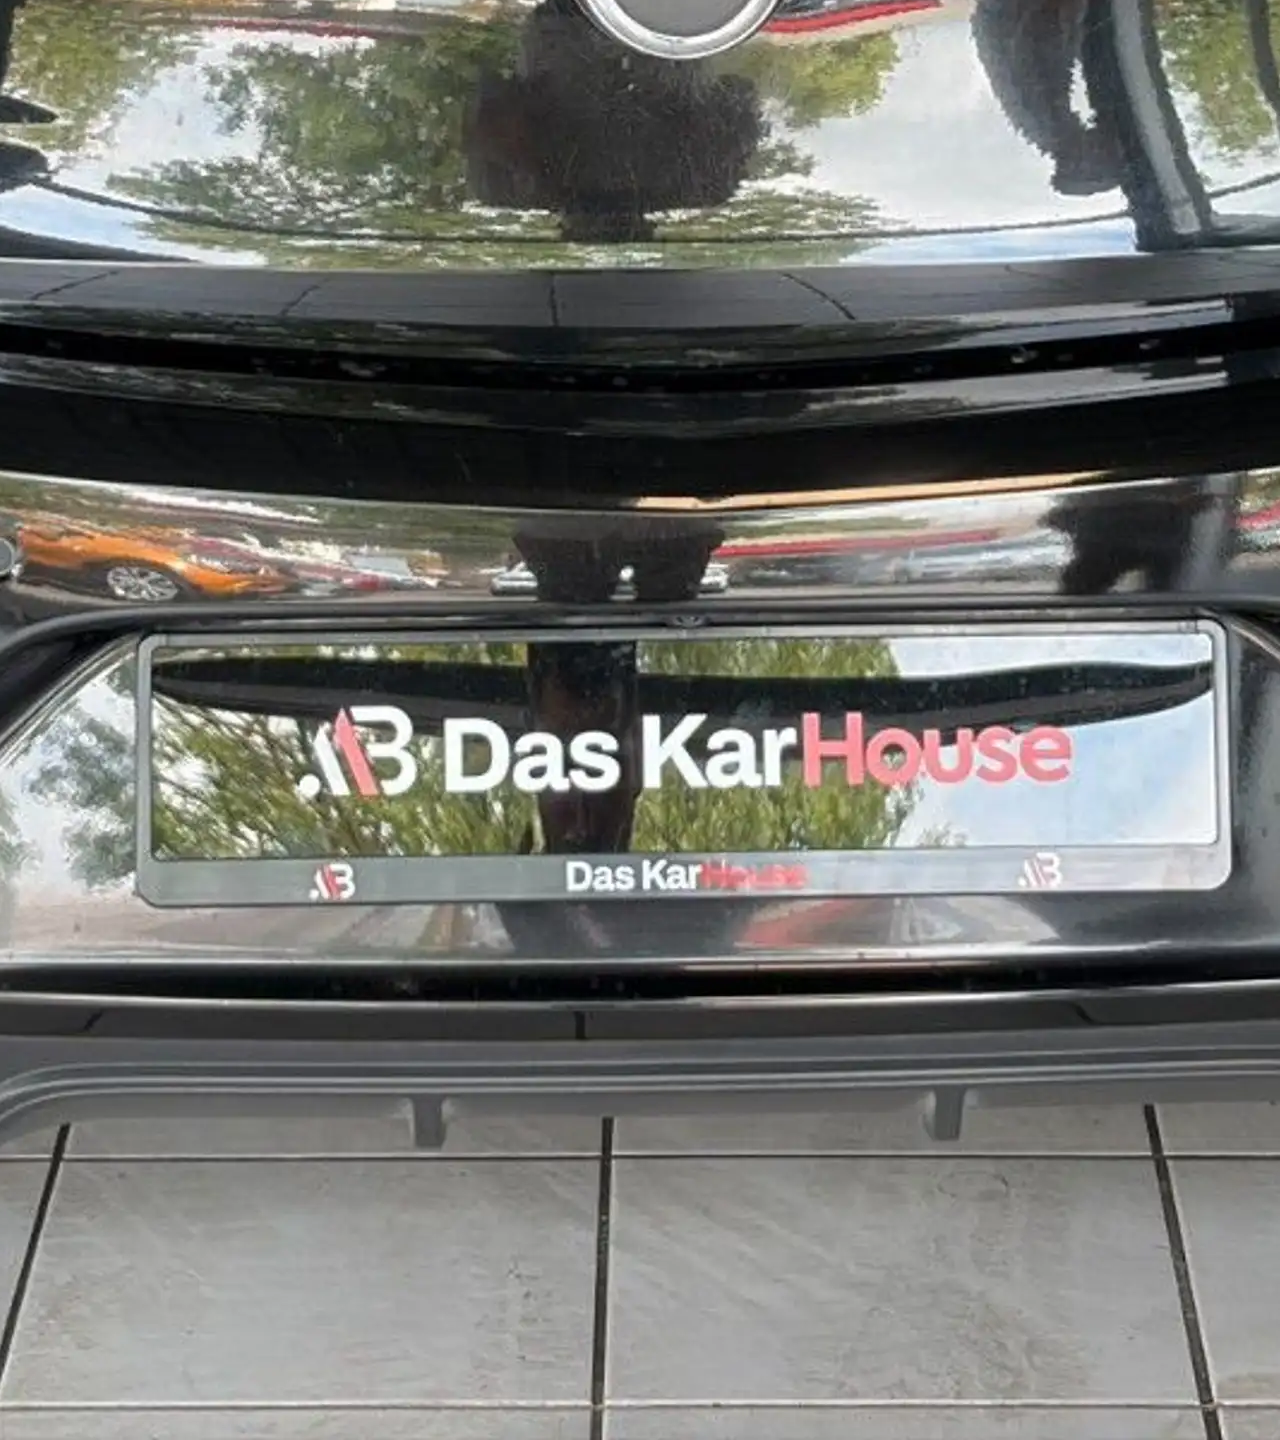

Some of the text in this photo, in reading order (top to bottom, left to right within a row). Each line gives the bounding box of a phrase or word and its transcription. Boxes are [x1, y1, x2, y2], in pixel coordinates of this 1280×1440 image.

[443, 716, 621, 792] Das
[642, 711, 1073, 789] KarHouse
[565, 859, 809, 892] Das KarHouse
